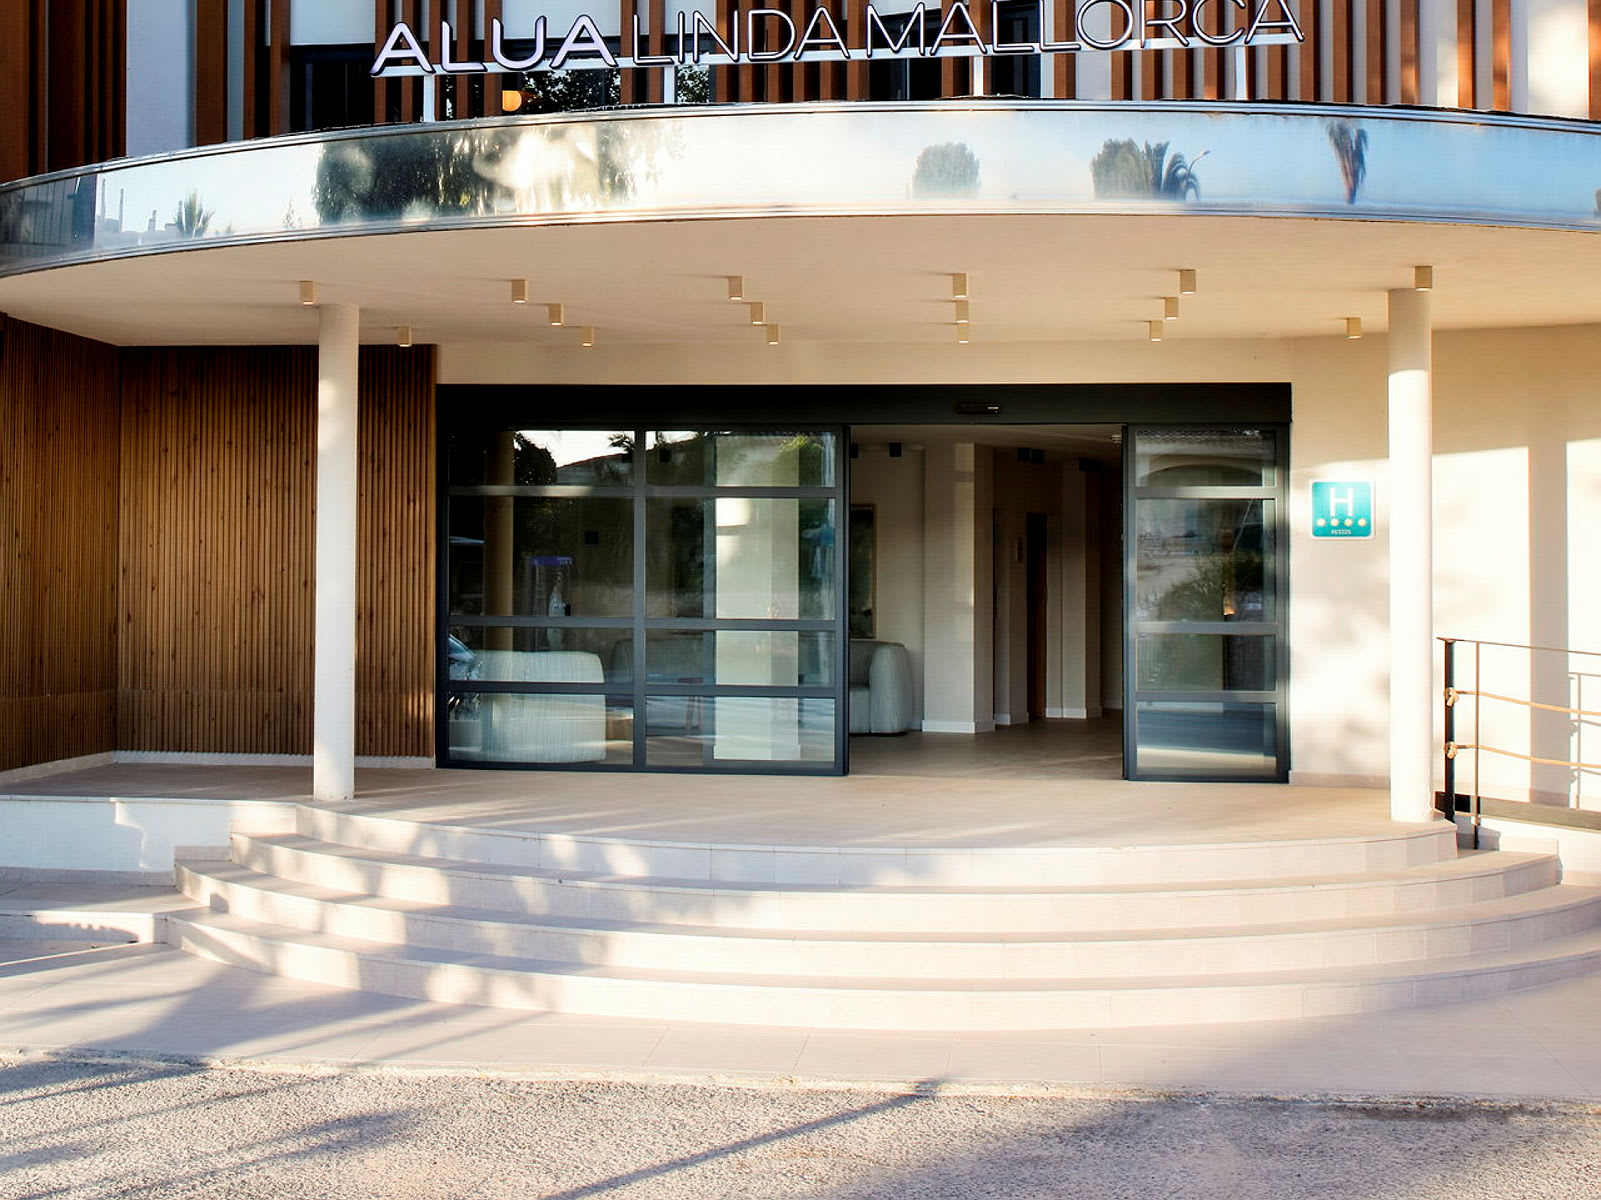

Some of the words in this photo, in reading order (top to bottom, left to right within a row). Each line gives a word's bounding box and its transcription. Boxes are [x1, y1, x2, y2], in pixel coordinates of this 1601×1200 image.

[370, 14, 619, 77] ALUA
[632, 6, 851, 66] LINDA
[1330, 487, 1354, 517] H
